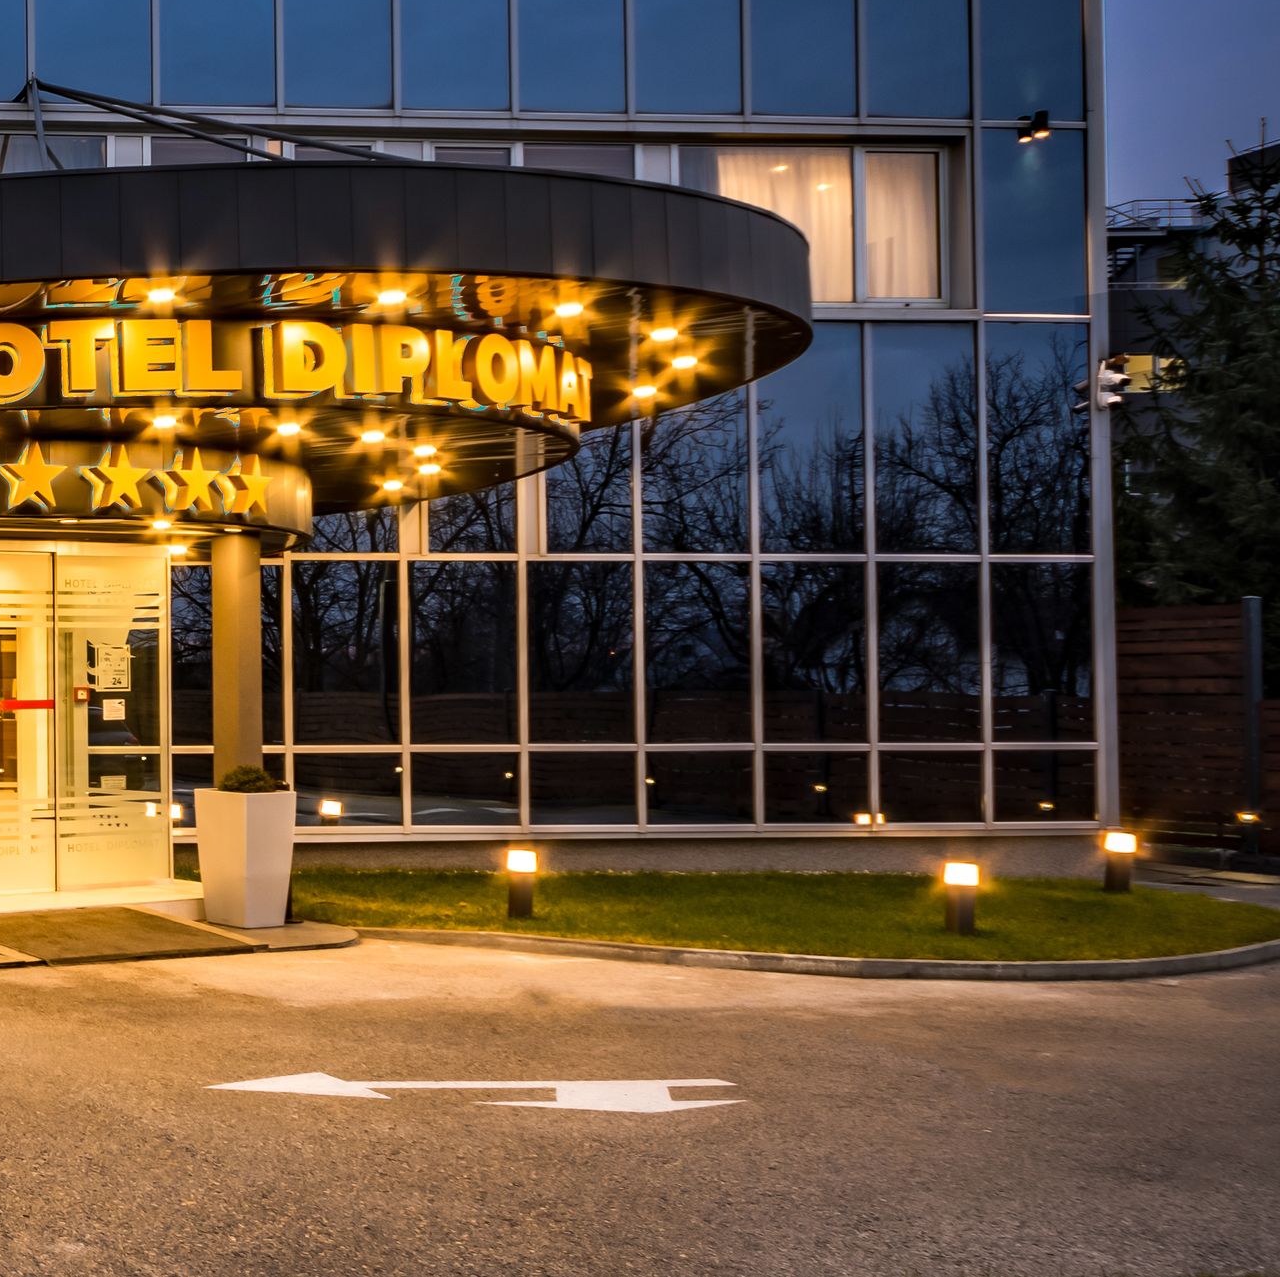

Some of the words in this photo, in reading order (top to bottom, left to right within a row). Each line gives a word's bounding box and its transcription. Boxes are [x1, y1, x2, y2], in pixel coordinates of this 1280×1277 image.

[266, 321, 593, 424] DIPLOMAT
[111, 677, 123, 686] 24
[67, 842, 100, 854] HOTEL
